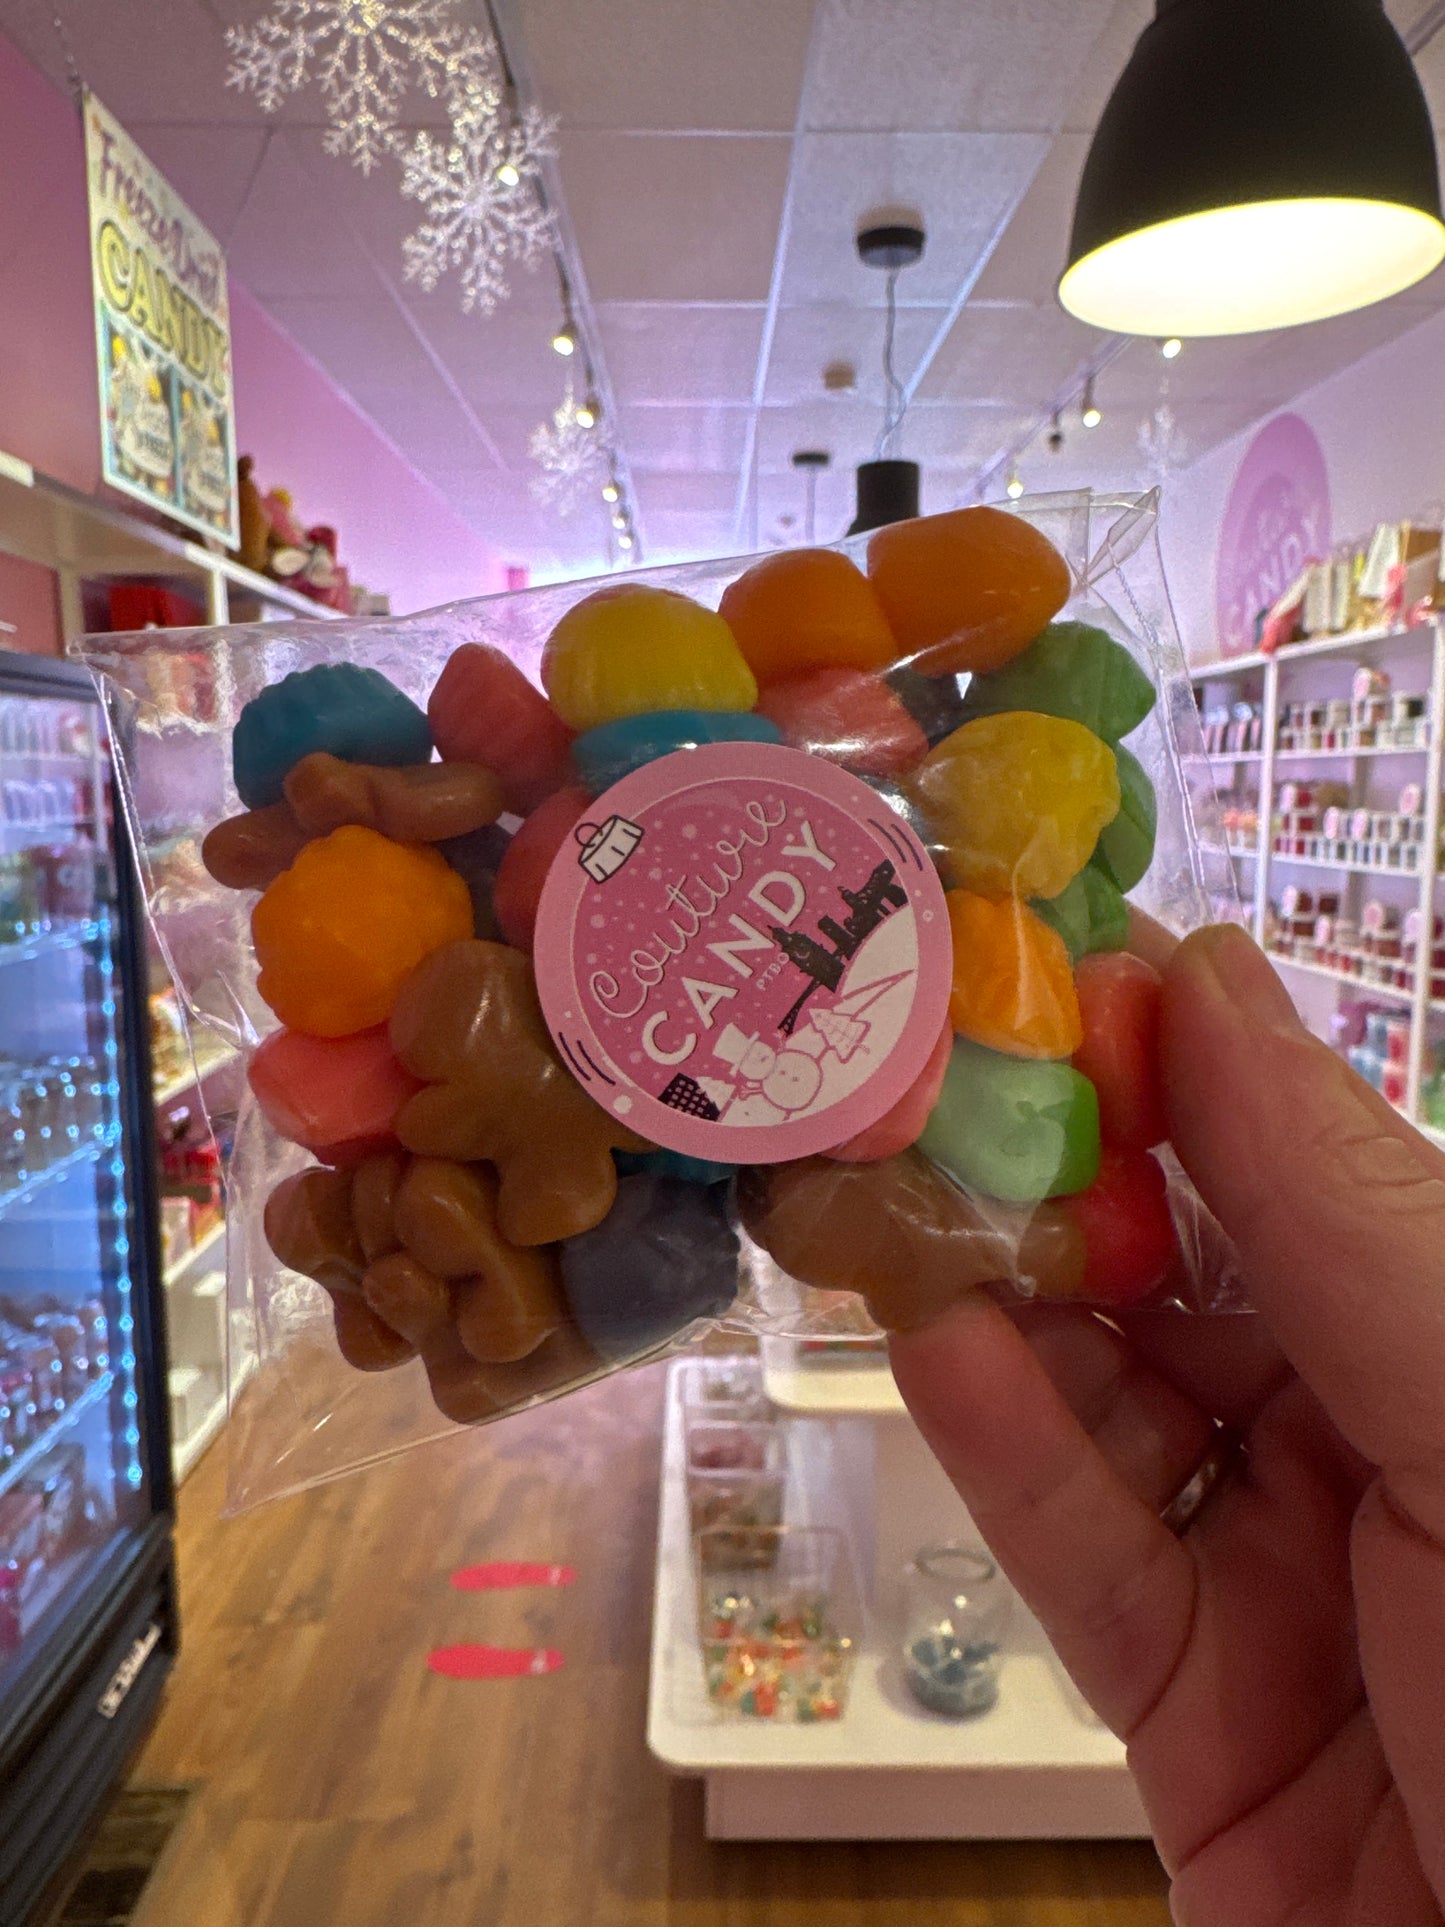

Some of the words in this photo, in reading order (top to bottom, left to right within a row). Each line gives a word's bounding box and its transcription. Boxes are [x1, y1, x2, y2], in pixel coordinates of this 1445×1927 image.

[99, 218, 227, 398] CANDY
[589, 799, 787, 1018] Couture
[641, 820, 836, 1066] CANDY
[755, 951, 790, 992] PTBO
